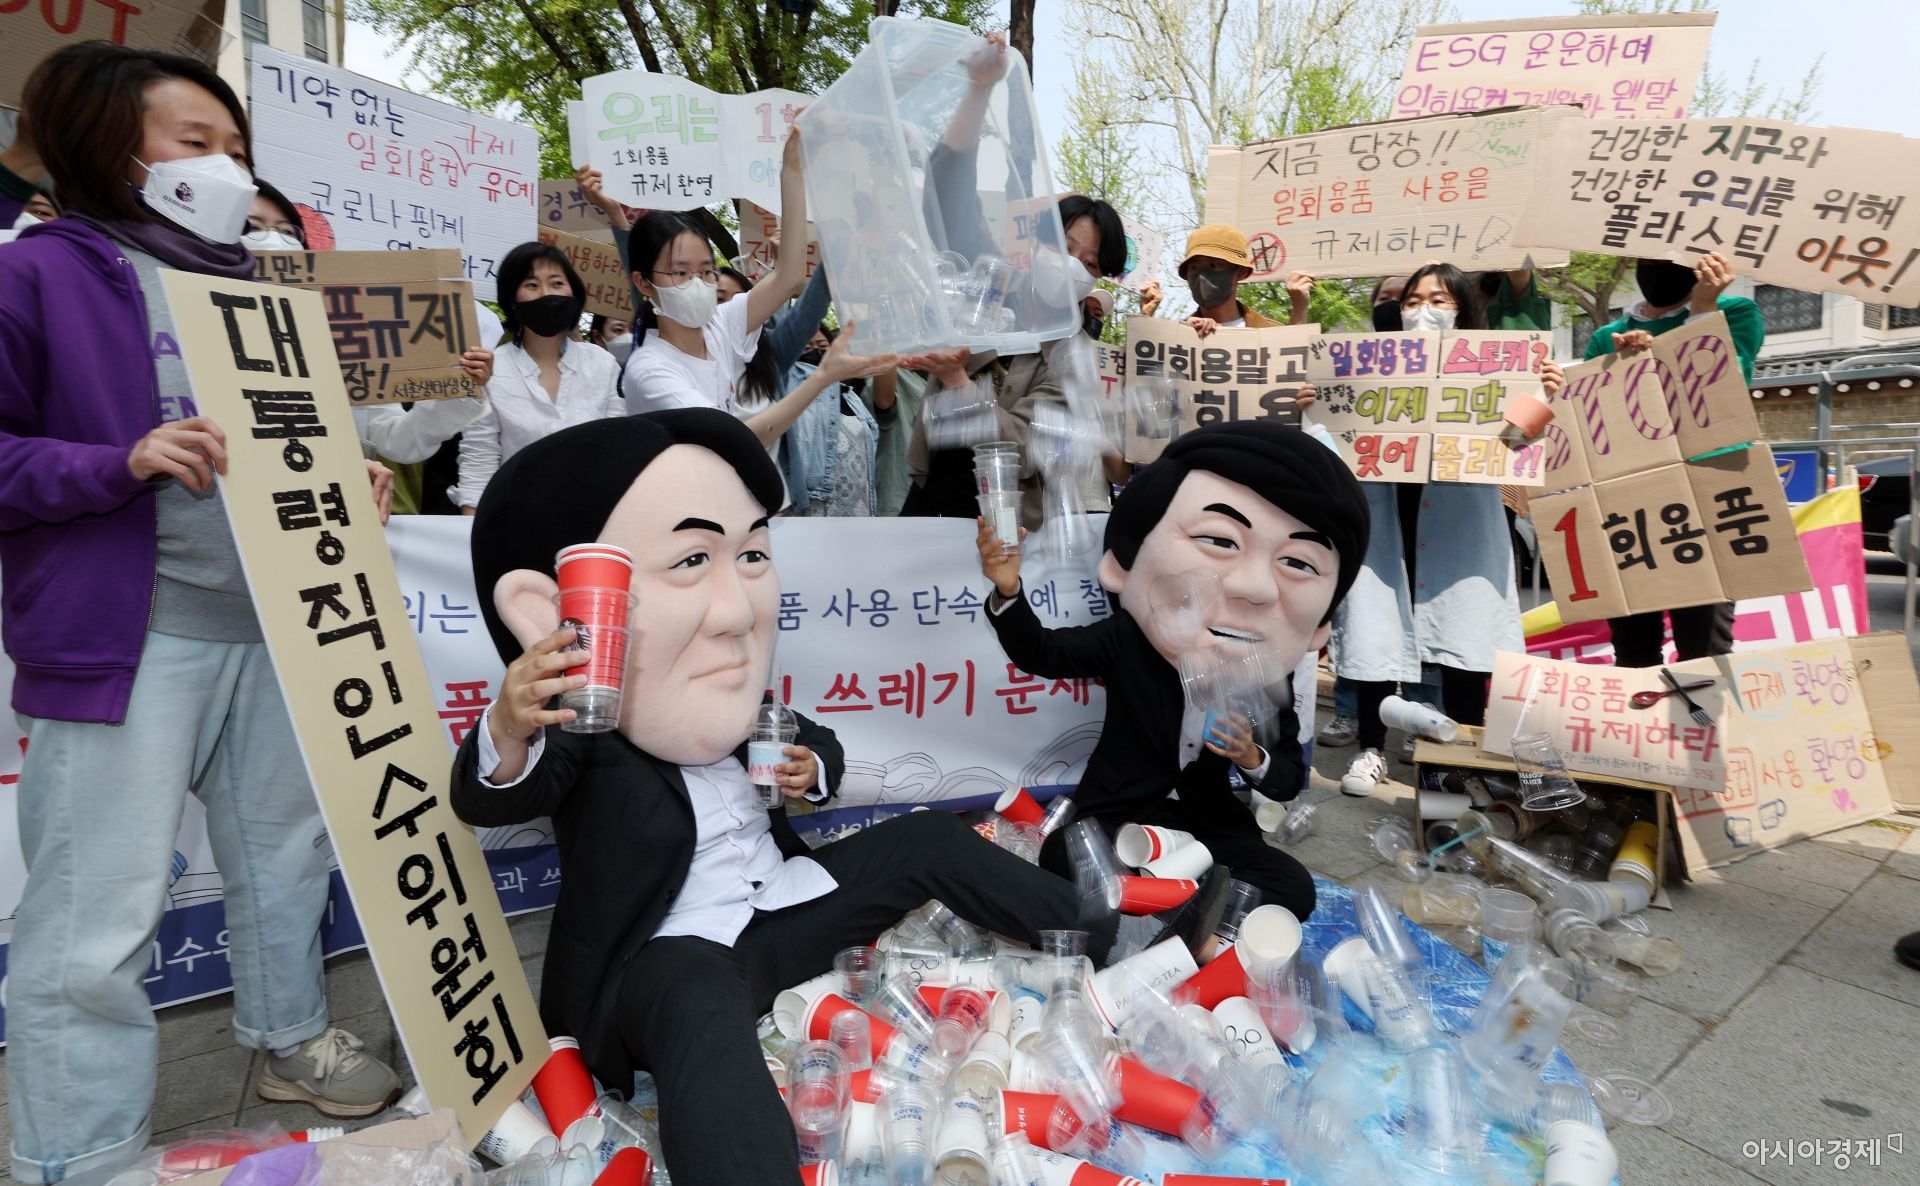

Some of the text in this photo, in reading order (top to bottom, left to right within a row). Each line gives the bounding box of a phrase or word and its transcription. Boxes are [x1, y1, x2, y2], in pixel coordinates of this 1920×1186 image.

[0, 0, 141, 45] UT
[1416, 31, 1654, 72] ESG 운운하며
[262, 65, 405, 137] 기약 없는
[598, 92, 719, 145] 우리는
[347, 121, 535, 207] 일회용컵 규제 유예
[613, 146, 670, 166] 1회용품
[1252, 129, 1460, 181] 지금 당장!!
[1589, 123, 1828, 169] 건강한 지구와
[631, 173, 714, 197] 규제 환영
[1273, 166, 1490, 226] 일회용품 사용을
[1571, 167, 1906, 231] 건강한 우리를 위해
[310, 181, 465, 243] 코로나 핑계
[1601, 204, 1920, 294] 플라스틱 아웃!
[1135, 340, 1307, 384] 일회용말고
[1329, 338, 1428, 377] 일회용컵
[1355, 386, 1428, 424] 이제
[1436, 379, 1506, 425] 그만
[1354, 434, 1419, 478] 잊어
[1554, 486, 1770, 602] 1회용품
[403, 591, 477, 634] 는
[822, 588, 898, 628] 사용
[913, 585, 983, 623] 단속
[210, 290, 527, 1107] 대통령직인수위원회
[816, 662, 975, 718] 쓰레기
[996, 663, 1107, 715] 문제
[1502, 663, 1627, 714] 1회용품
[1741, 655, 1850, 711] 규제 환영
[1565, 716, 1721, 763] 규제하라
[1762, 749, 1804, 789] 사용
[1807, 735, 1867, 785] 환영
[492, 867, 528, 893] 과
[1162, 966, 1182, 981] TEA
